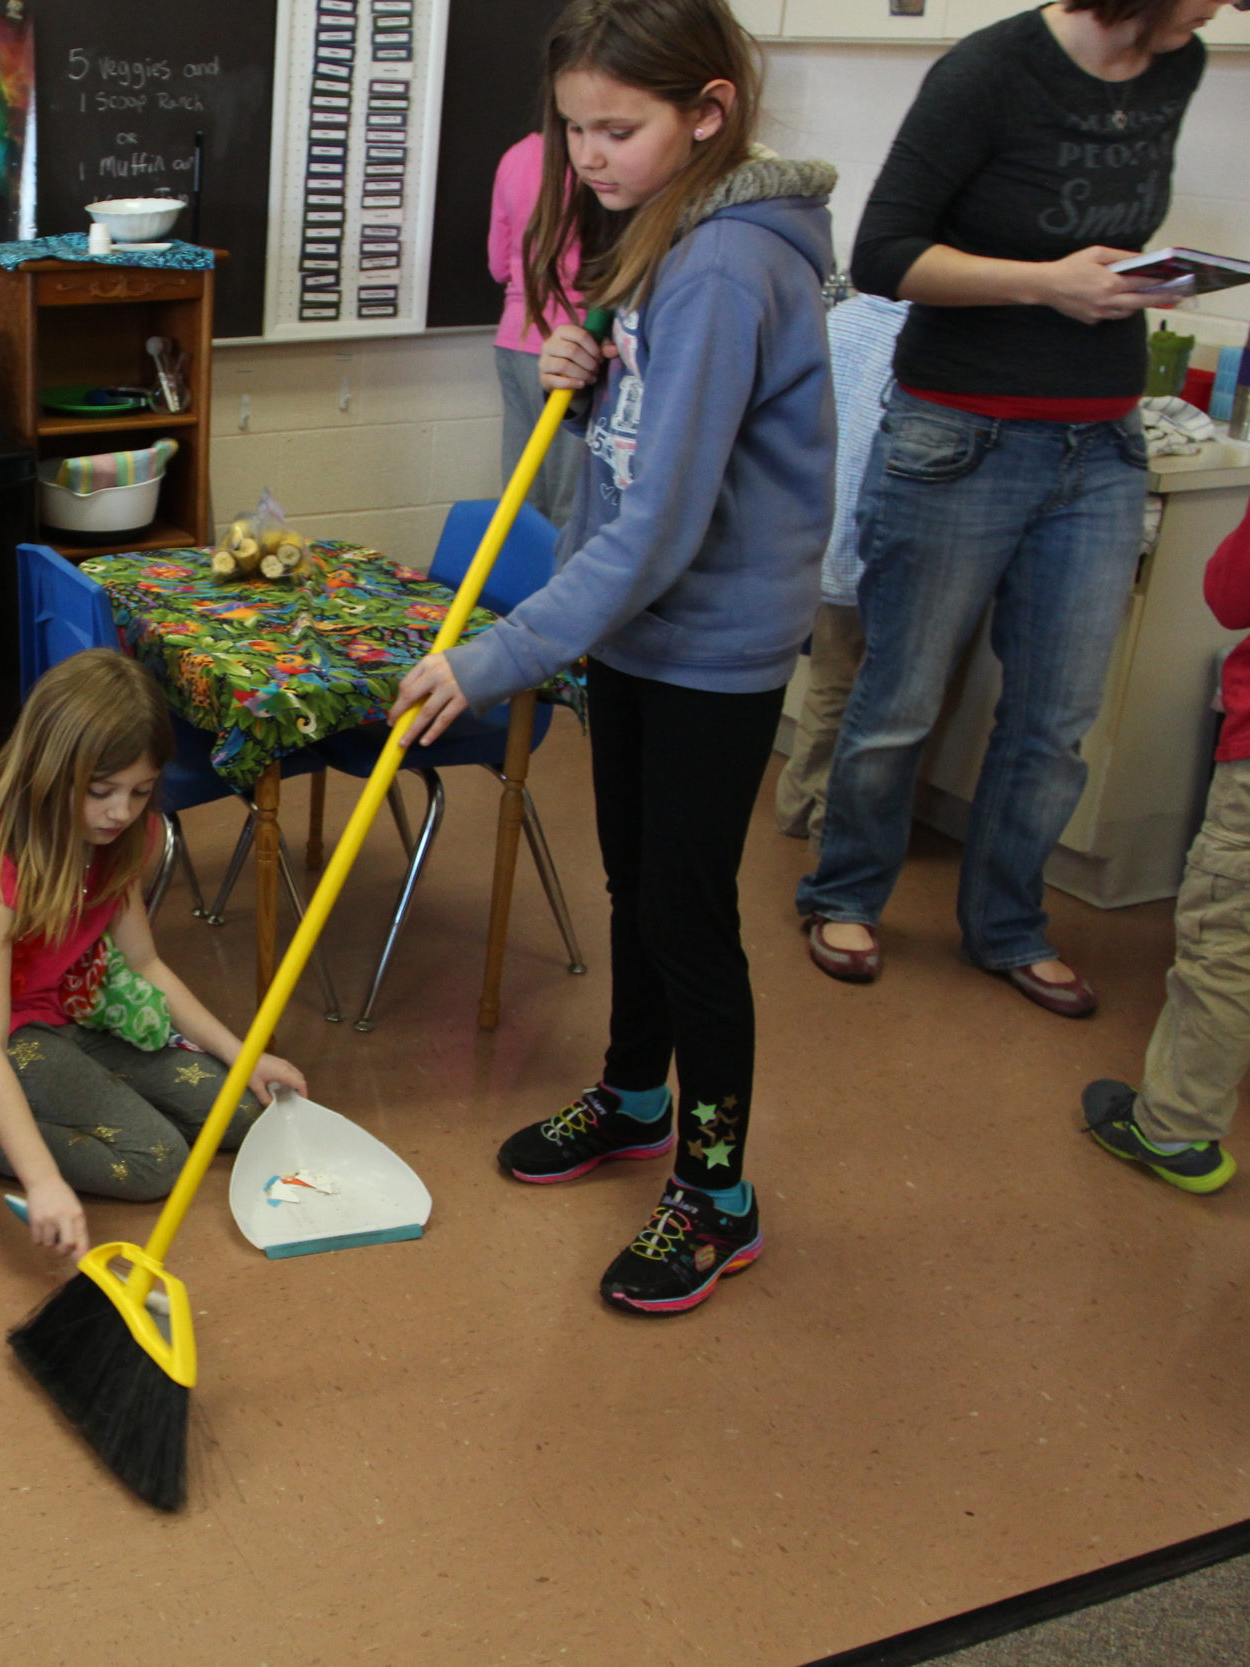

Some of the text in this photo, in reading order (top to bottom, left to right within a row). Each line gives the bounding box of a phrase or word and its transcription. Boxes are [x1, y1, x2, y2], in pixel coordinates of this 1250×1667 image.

[67, 47, 90, 81] 5
[183, 55, 220, 79] and
[95, 91, 148, 113] Scoop
[156, 92, 204, 112] Ranch
[98, 152, 166, 178] Muffin
[1037, 170, 1166, 239] Smil
